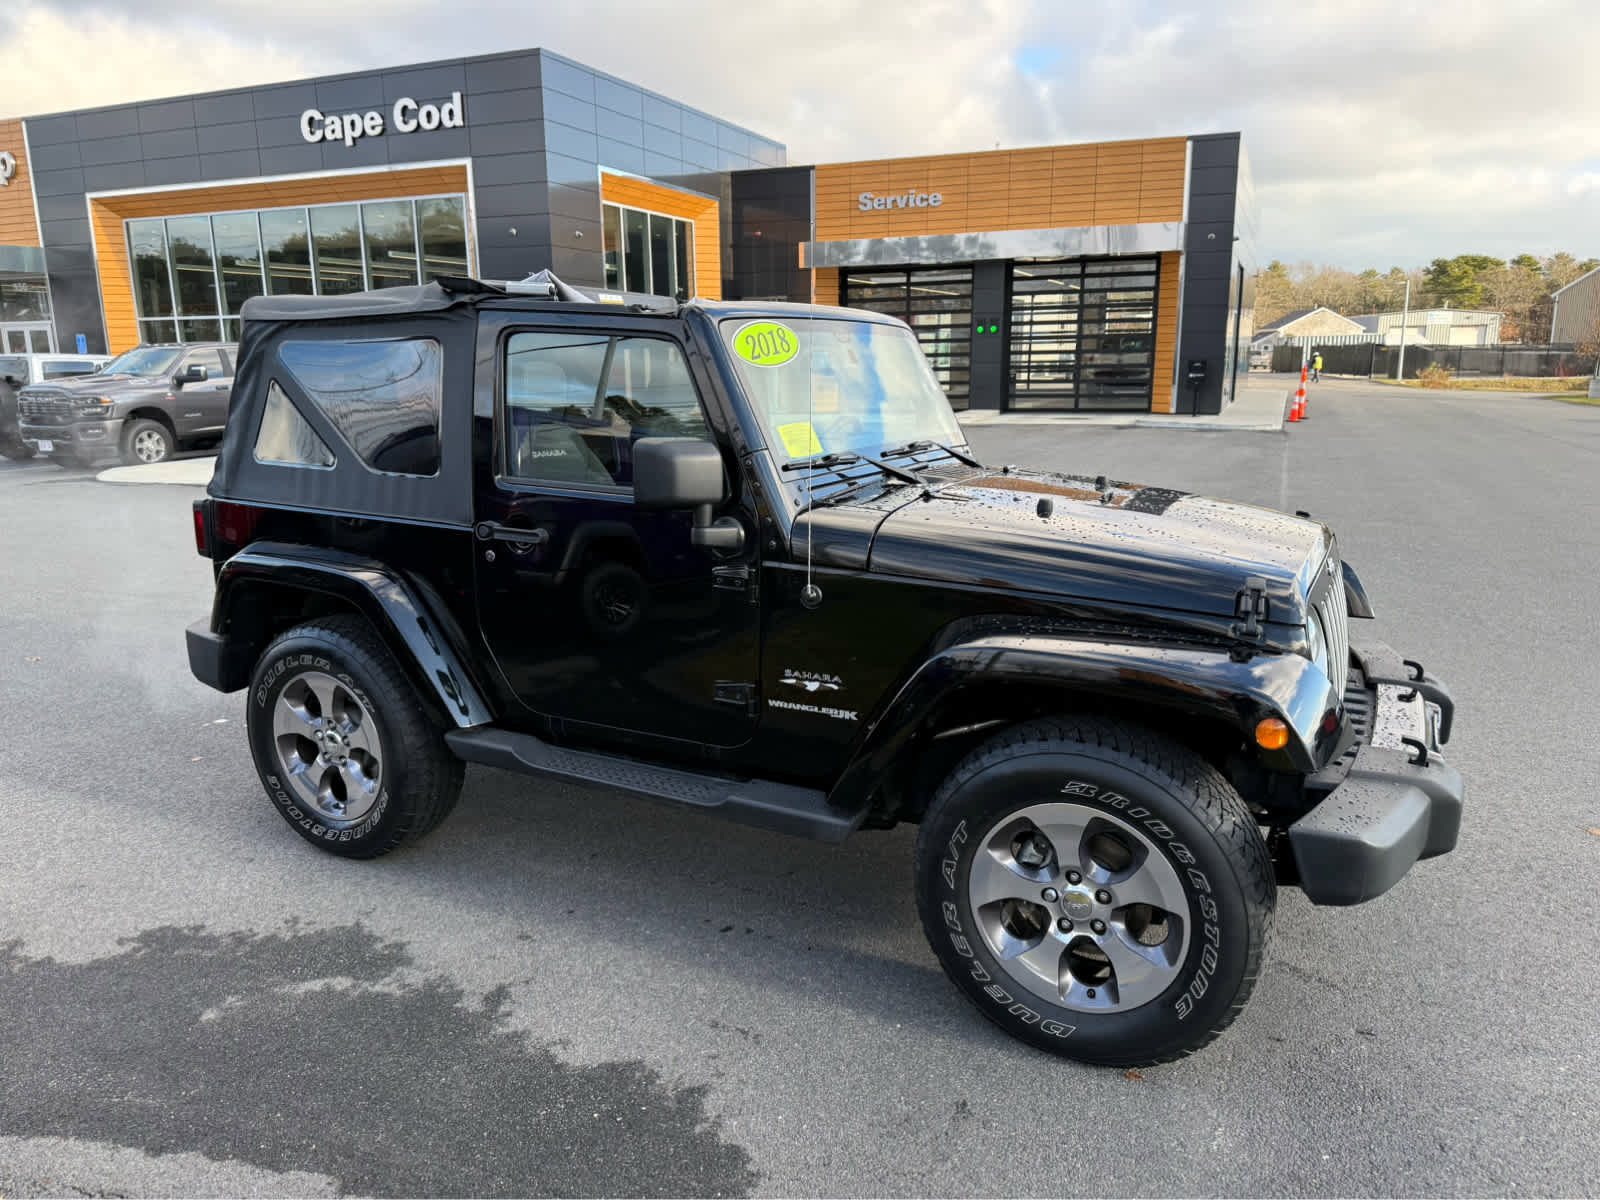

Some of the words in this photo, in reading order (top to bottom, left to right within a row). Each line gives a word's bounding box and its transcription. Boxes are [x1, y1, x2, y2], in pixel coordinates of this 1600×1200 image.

[300, 108, 385, 147] Cape
[393, 91, 465, 133] Cod
[858, 188, 943, 211] Service
[745, 326, 792, 361] 2018
[256, 654, 332, 708] DUELER
[784, 669, 843, 683] SAHARA
[266, 775, 390, 842] BRIDGESTONE
[941, 819, 970, 890] A/T
[1060, 780, 1221, 1021] BRIDGESTONE
[942, 902, 1077, 1039] DUELER
